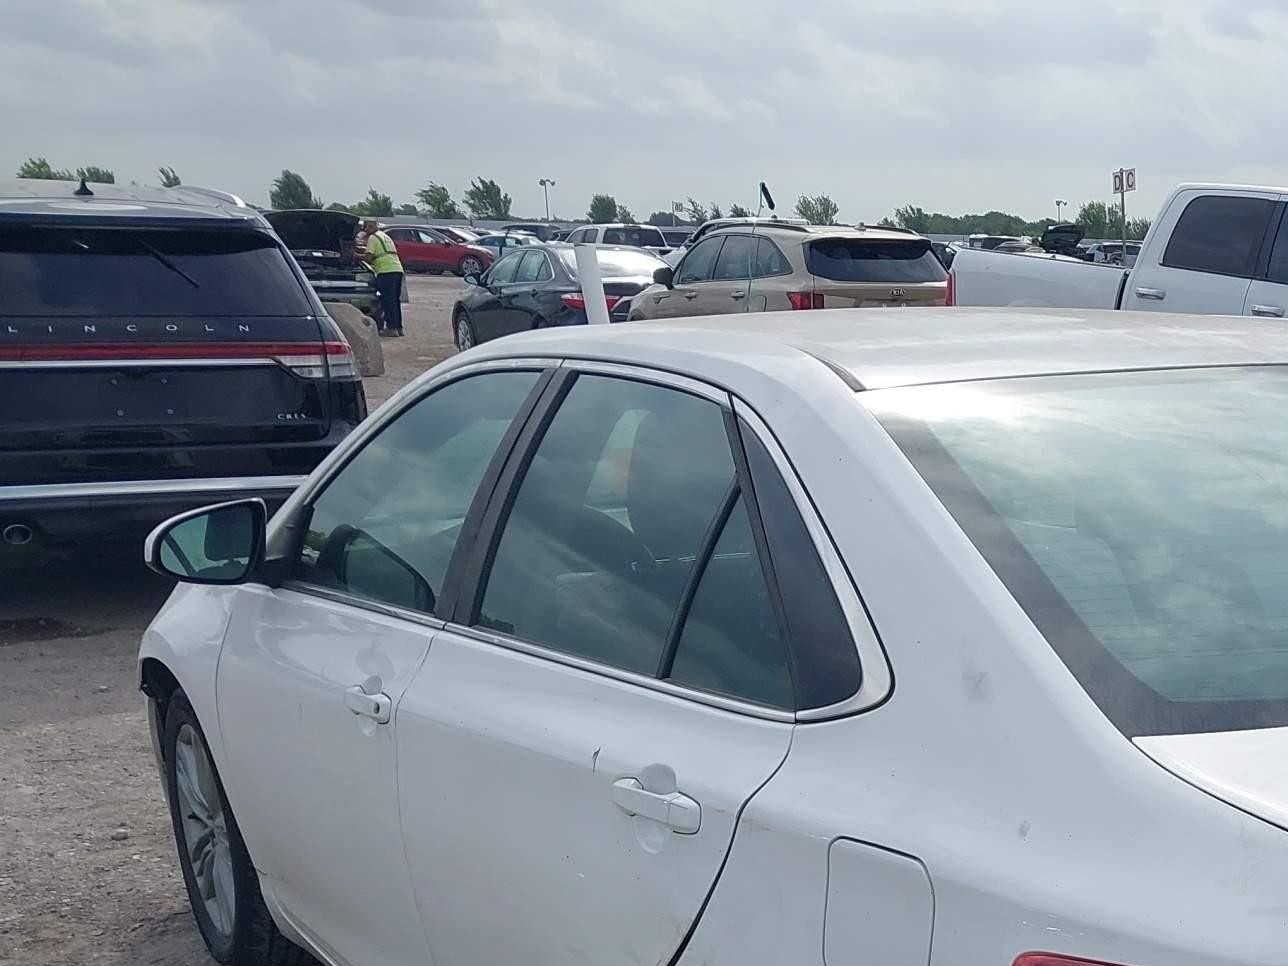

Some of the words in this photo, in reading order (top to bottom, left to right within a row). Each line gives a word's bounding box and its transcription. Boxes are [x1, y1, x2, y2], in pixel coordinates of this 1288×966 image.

[1114, 174, 1121, 191] D
[1127, 171, 1134, 188] C
[8, 324, 250, 334] LINCOLN
